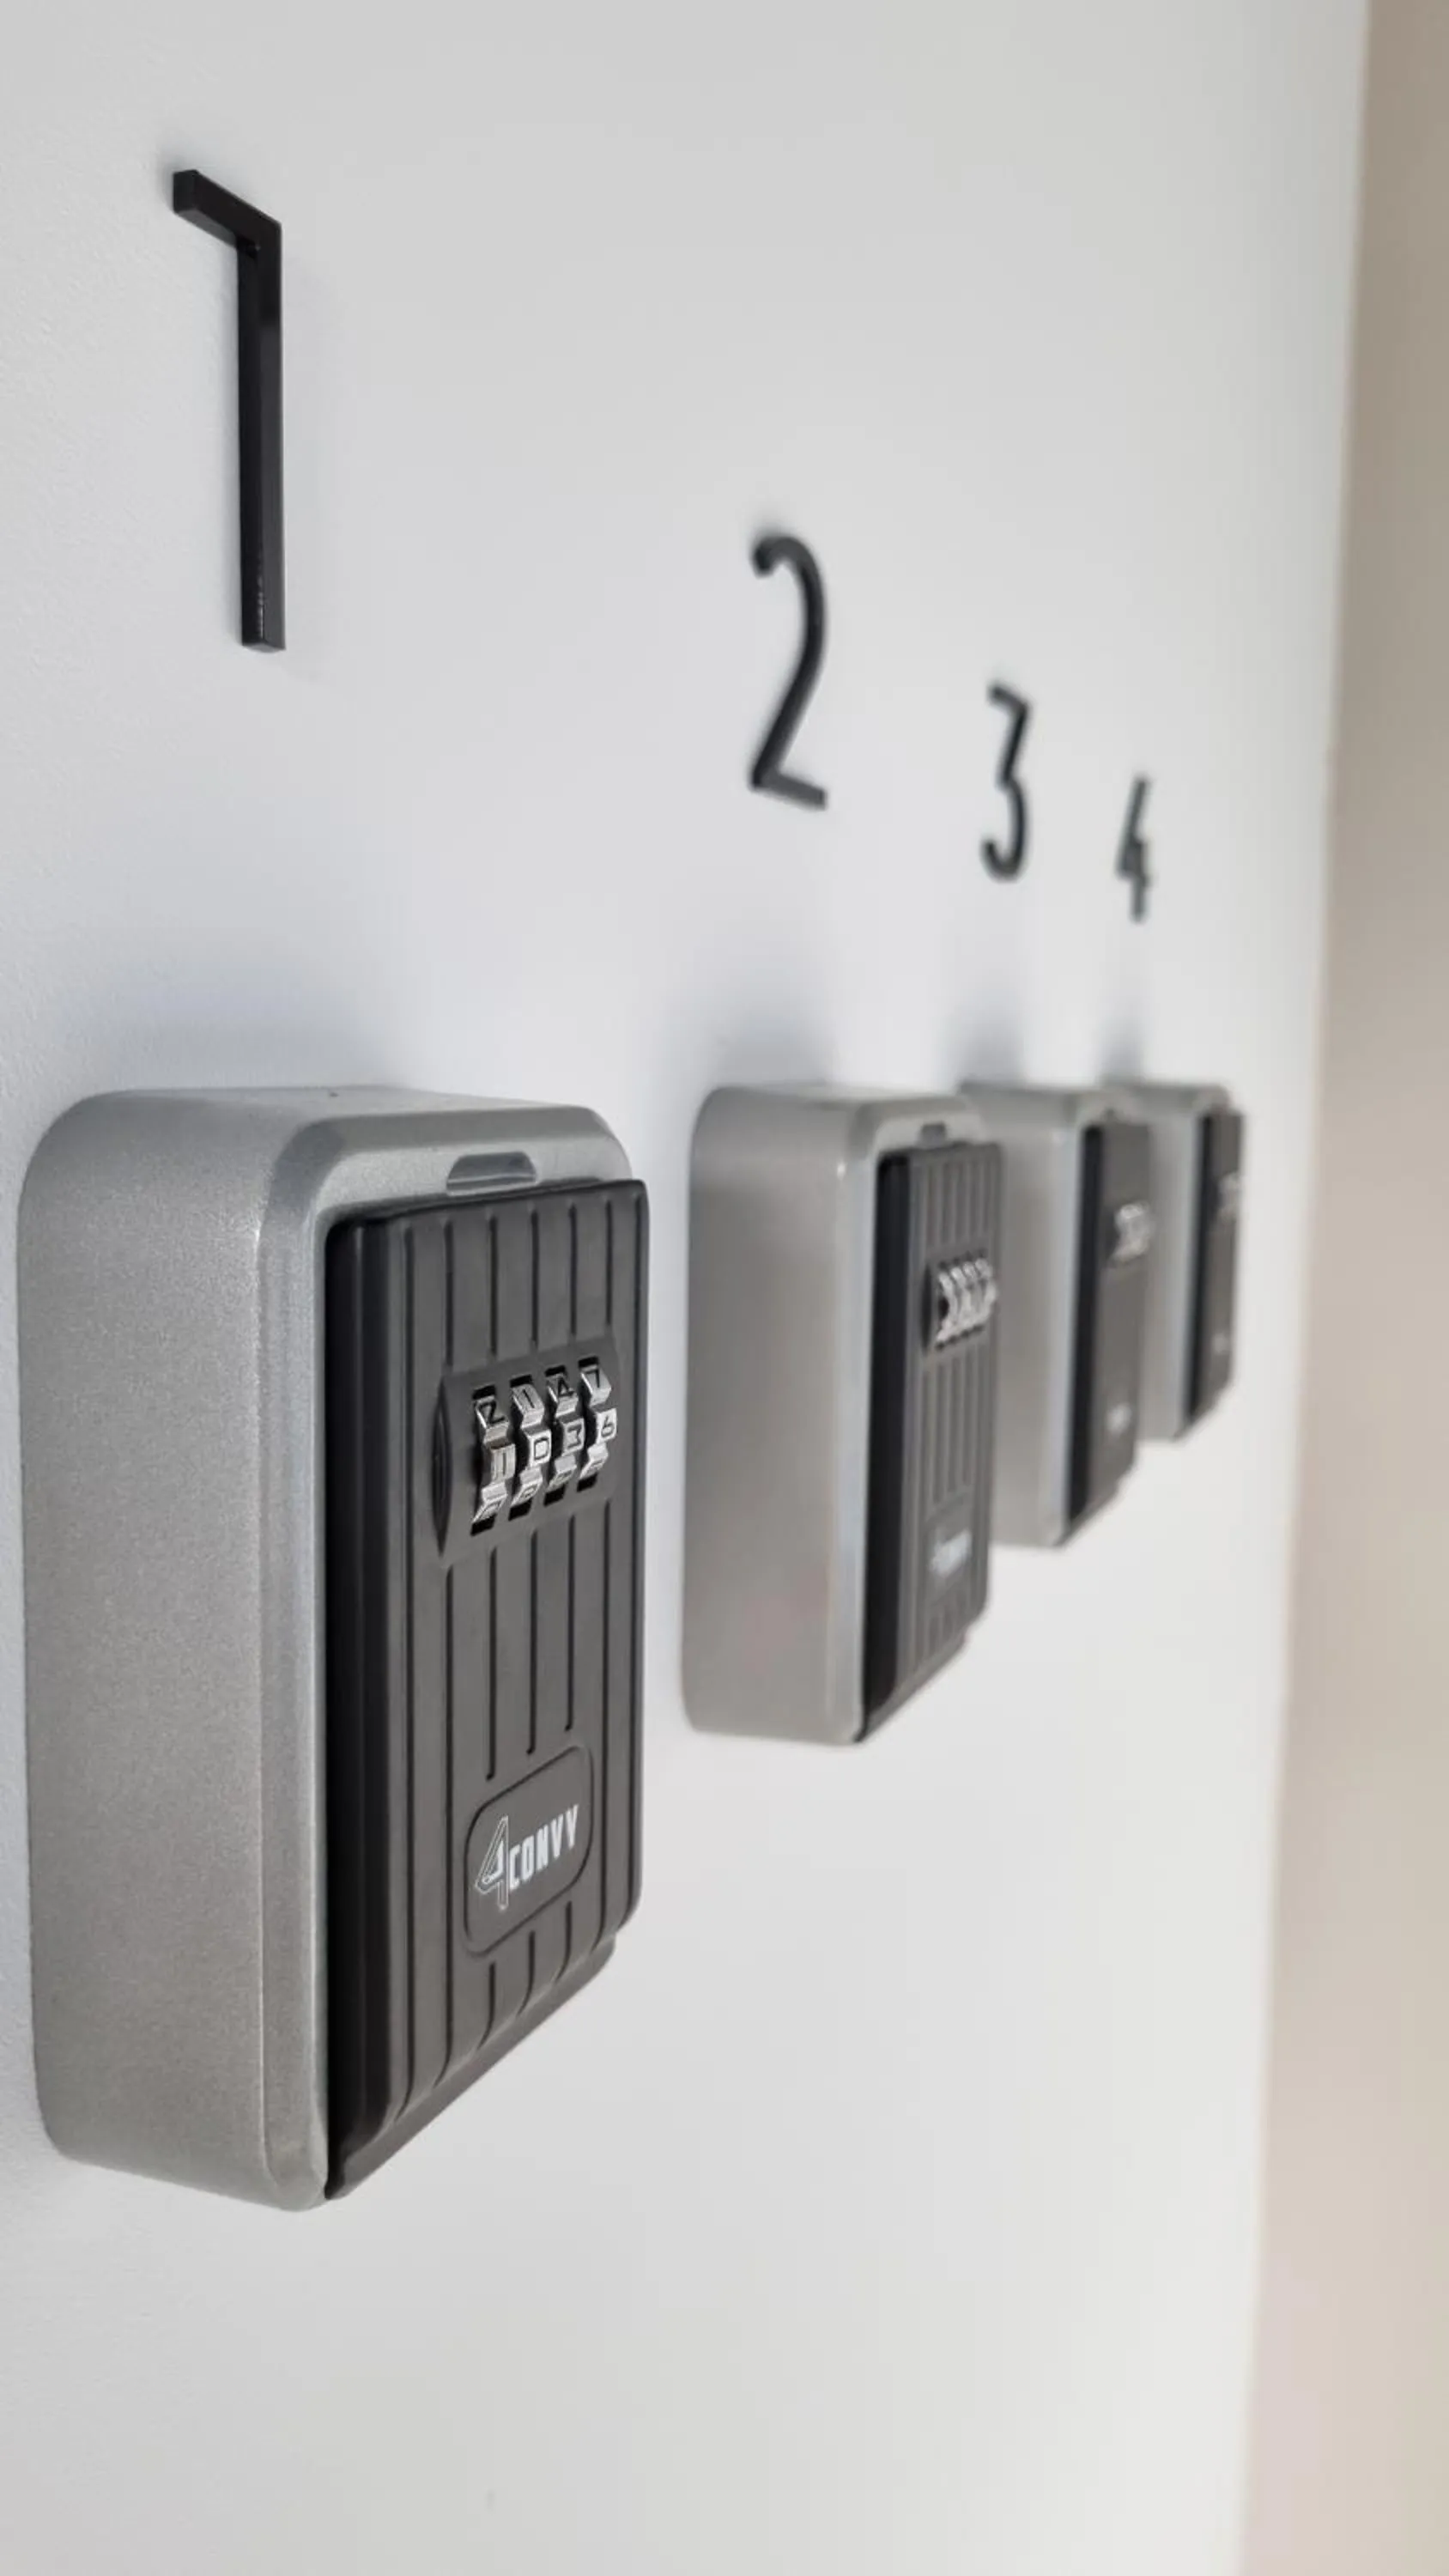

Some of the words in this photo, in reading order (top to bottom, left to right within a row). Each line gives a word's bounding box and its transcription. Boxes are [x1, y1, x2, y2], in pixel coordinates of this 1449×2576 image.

[173, 169, 286, 650] 1
[750, 533, 828, 809] 2
[981, 681, 1032, 883] 3
[1117, 775, 1150, 921] 4
